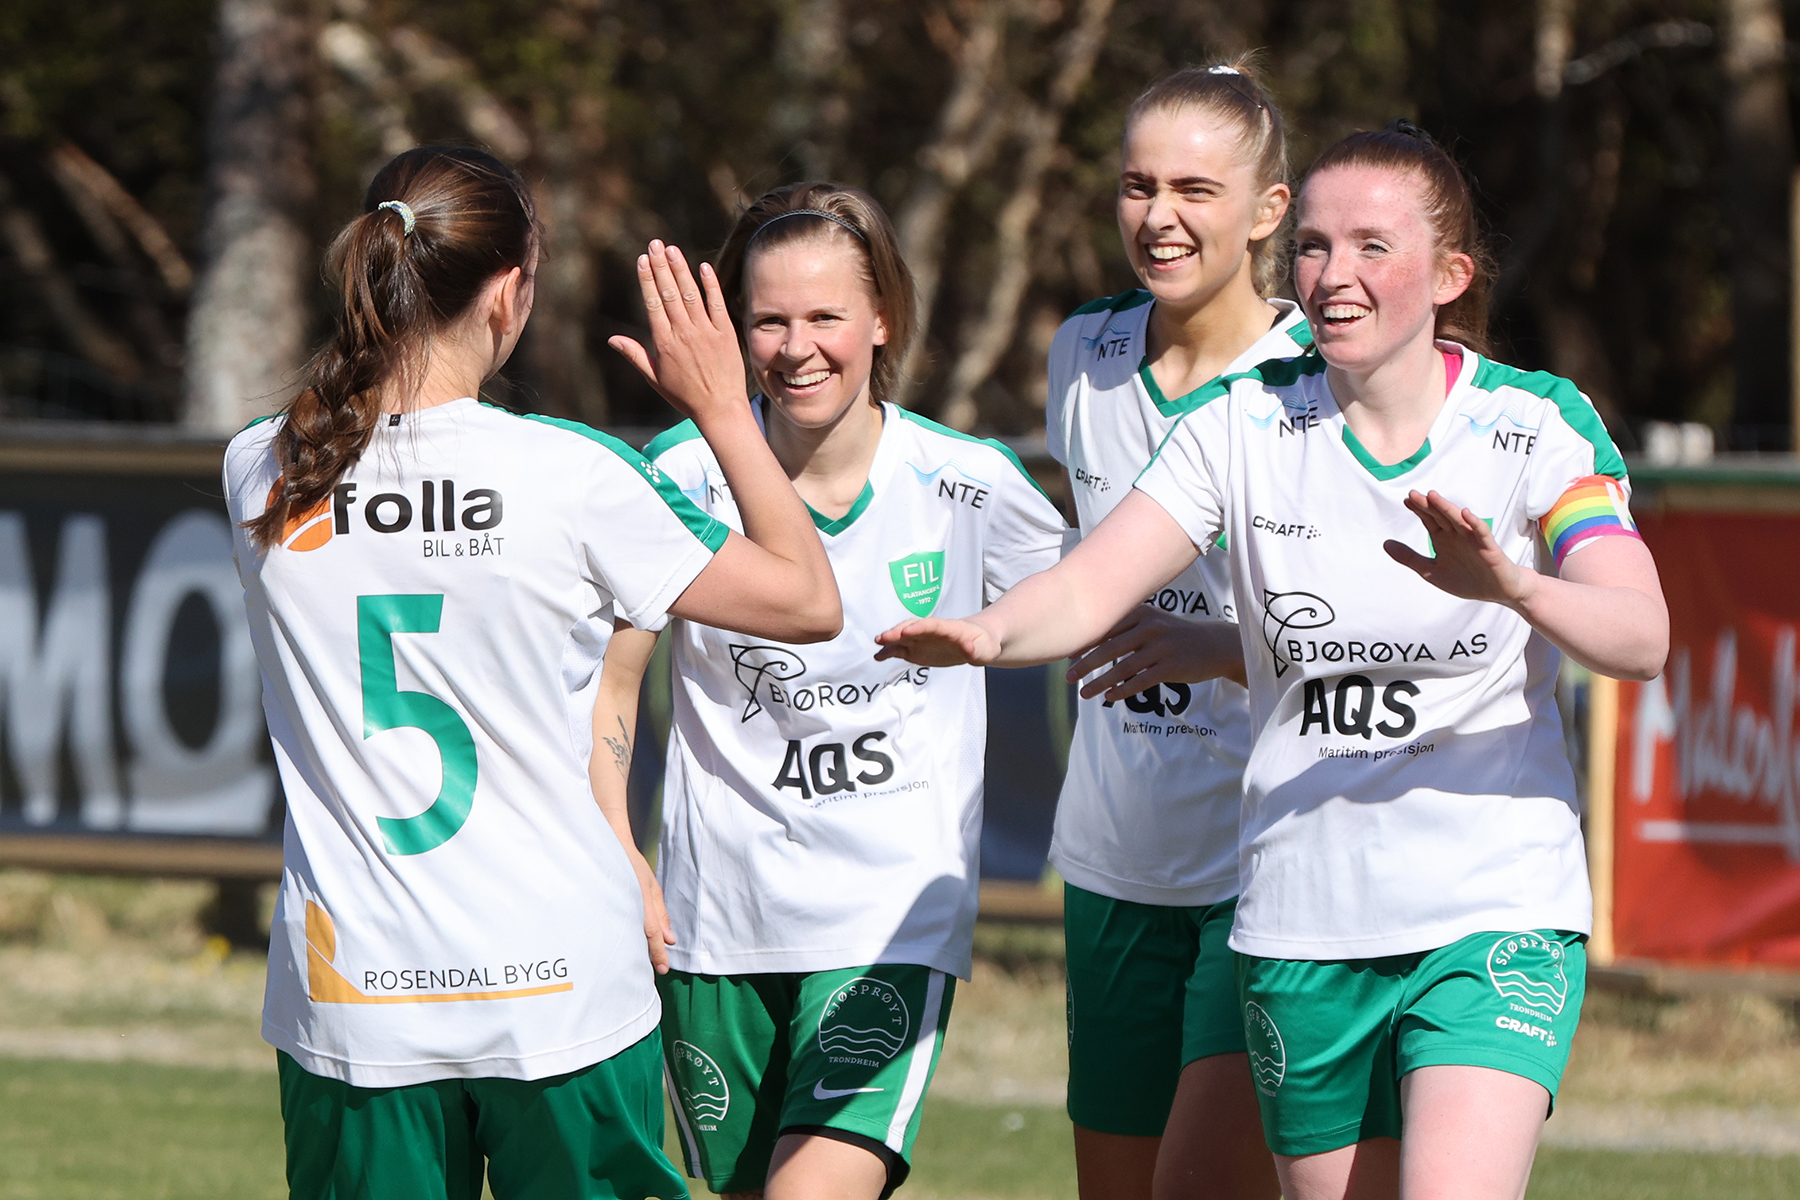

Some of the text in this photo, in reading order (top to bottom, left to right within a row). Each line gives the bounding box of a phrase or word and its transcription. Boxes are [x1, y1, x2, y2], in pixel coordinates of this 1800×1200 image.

[1097, 337, 1131, 362] NTE
[1279, 406, 1320, 438] NTE
[333, 479, 504, 535] folla
[938, 478, 990, 510] NTE
[1252, 515, 1306, 538] CRAFT
[423, 532, 505, 558] BIL & BÅT
[902, 560, 940, 588] FIL
[1143, 588, 1211, 616] RØYA
[1287, 633, 1488, 663] BJØRØYA AS
[893, 666, 931, 687] AS
[1299, 674, 1422, 741] AQS
[356, 593, 479, 856] 5
[771, 730, 895, 800] AQS
[1318, 745, 1369, 760] Maritim
[810, 793, 858, 809] aritim
[364, 957, 569, 991] ROSENDAL BYGG
[826, 984, 903, 1026] SJØSPRØYT
[1509, 1002, 1554, 1023] TRONDHEIM
[1495, 1015, 1549, 1042] CRAFT
[828, 1056, 881, 1069] TRONDHEIM
